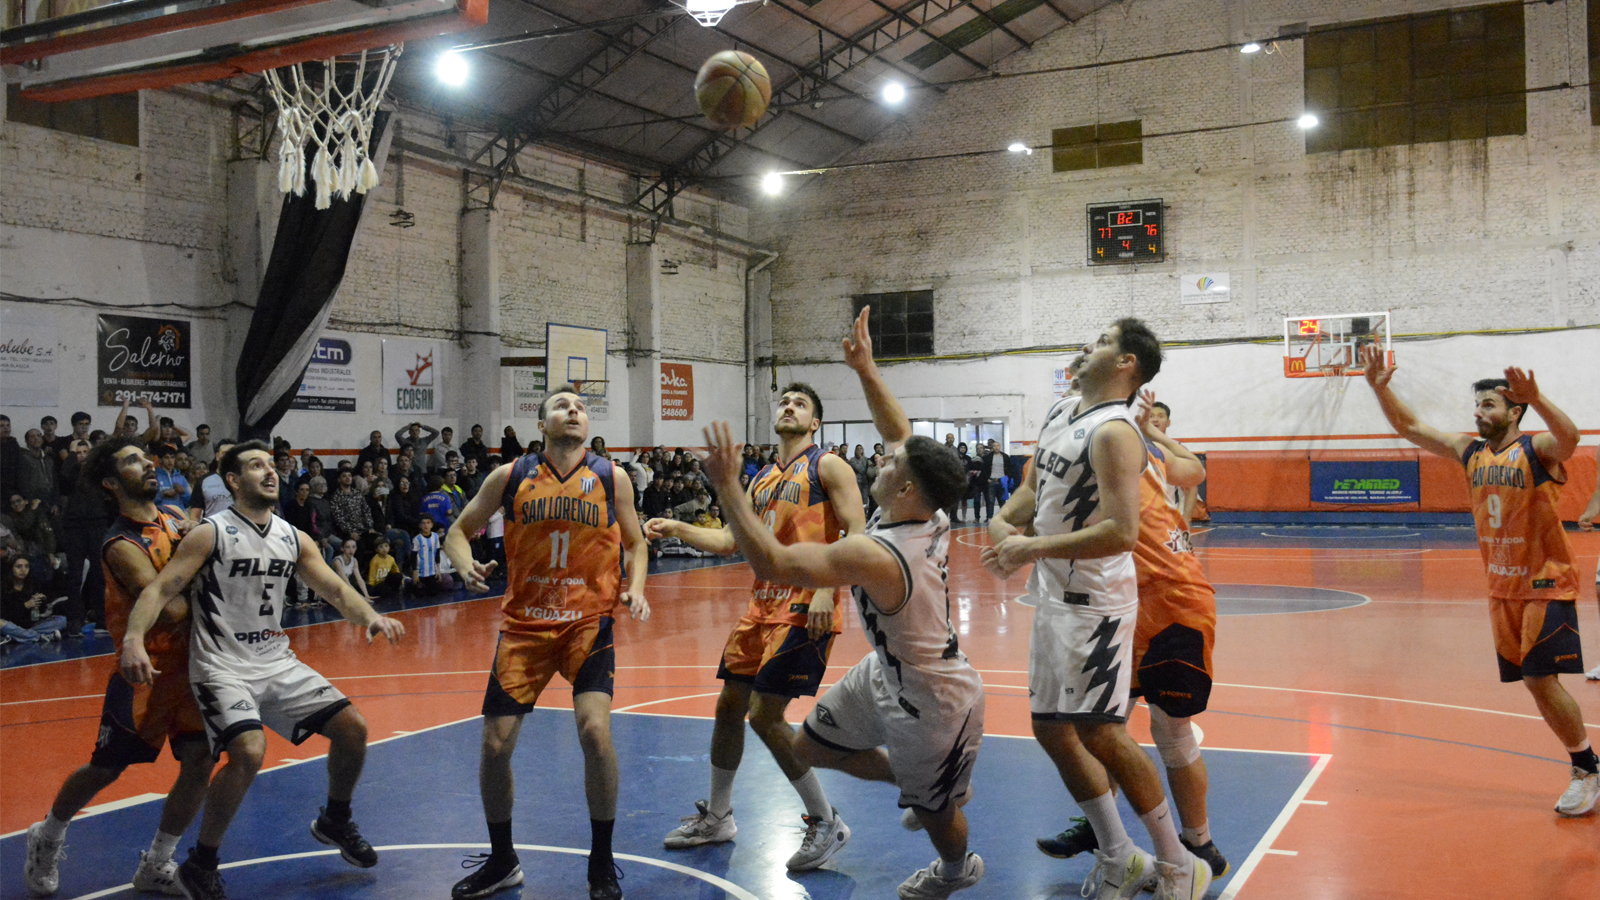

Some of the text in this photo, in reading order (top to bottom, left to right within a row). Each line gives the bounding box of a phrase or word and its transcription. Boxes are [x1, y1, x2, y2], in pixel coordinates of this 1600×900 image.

[1117, 211, 1134, 225] 82
[1098, 223, 1158, 239] 77 76
[1096, 240, 1156, 258] 4 4 4
[1299, 320, 1319, 334] 24
[105, 327, 185, 372] Salerno
[103, 377, 118, 385] VENTA
[396, 388, 434, 410] ECOSAN
[662, 399, 684, 407] DELIVERY
[661, 407, 688, 417] 548600
[521, 495, 600, 529] SAN LORENZO
[1487, 493, 1502, 529] 9
[1502, 536, 1525, 544] SODA
[550, 529, 570, 569] 11
[552, 577, 558, 586] Y
[560, 577, 586, 586] SODA
[258, 582, 275, 617] 5
[524, 606, 583, 621] YGUAZU
